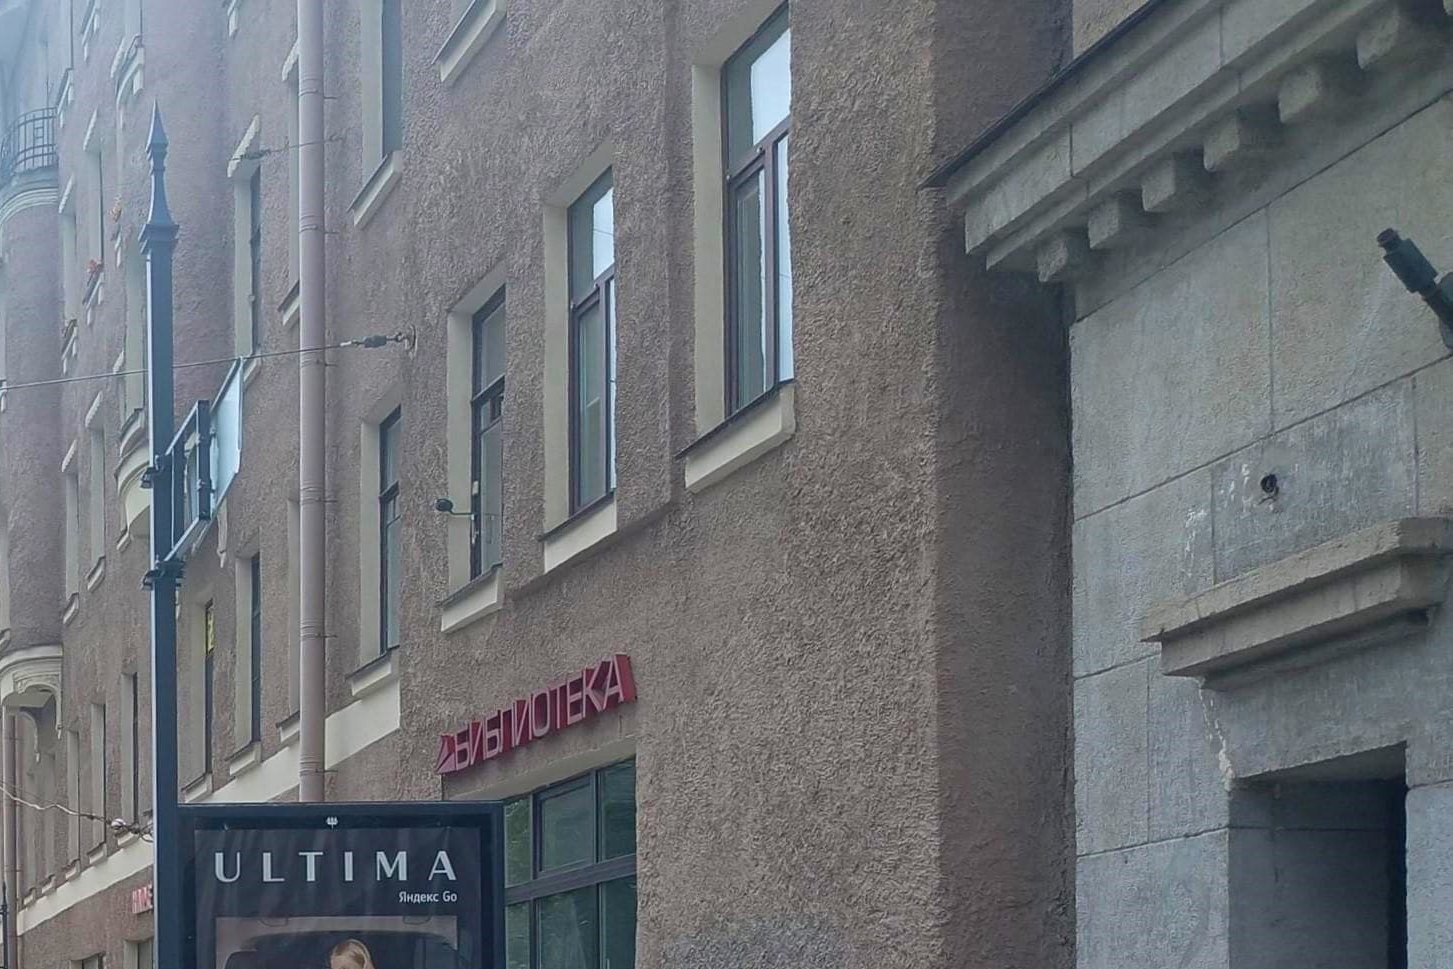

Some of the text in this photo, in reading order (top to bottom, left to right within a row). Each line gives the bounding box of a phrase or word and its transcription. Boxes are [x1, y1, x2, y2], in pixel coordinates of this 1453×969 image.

[454, 654, 637, 771] БИБЛИОТЕКА
[215, 850, 457, 883] ULTIMA
[399, 891, 457, 904] Яндекс Go
